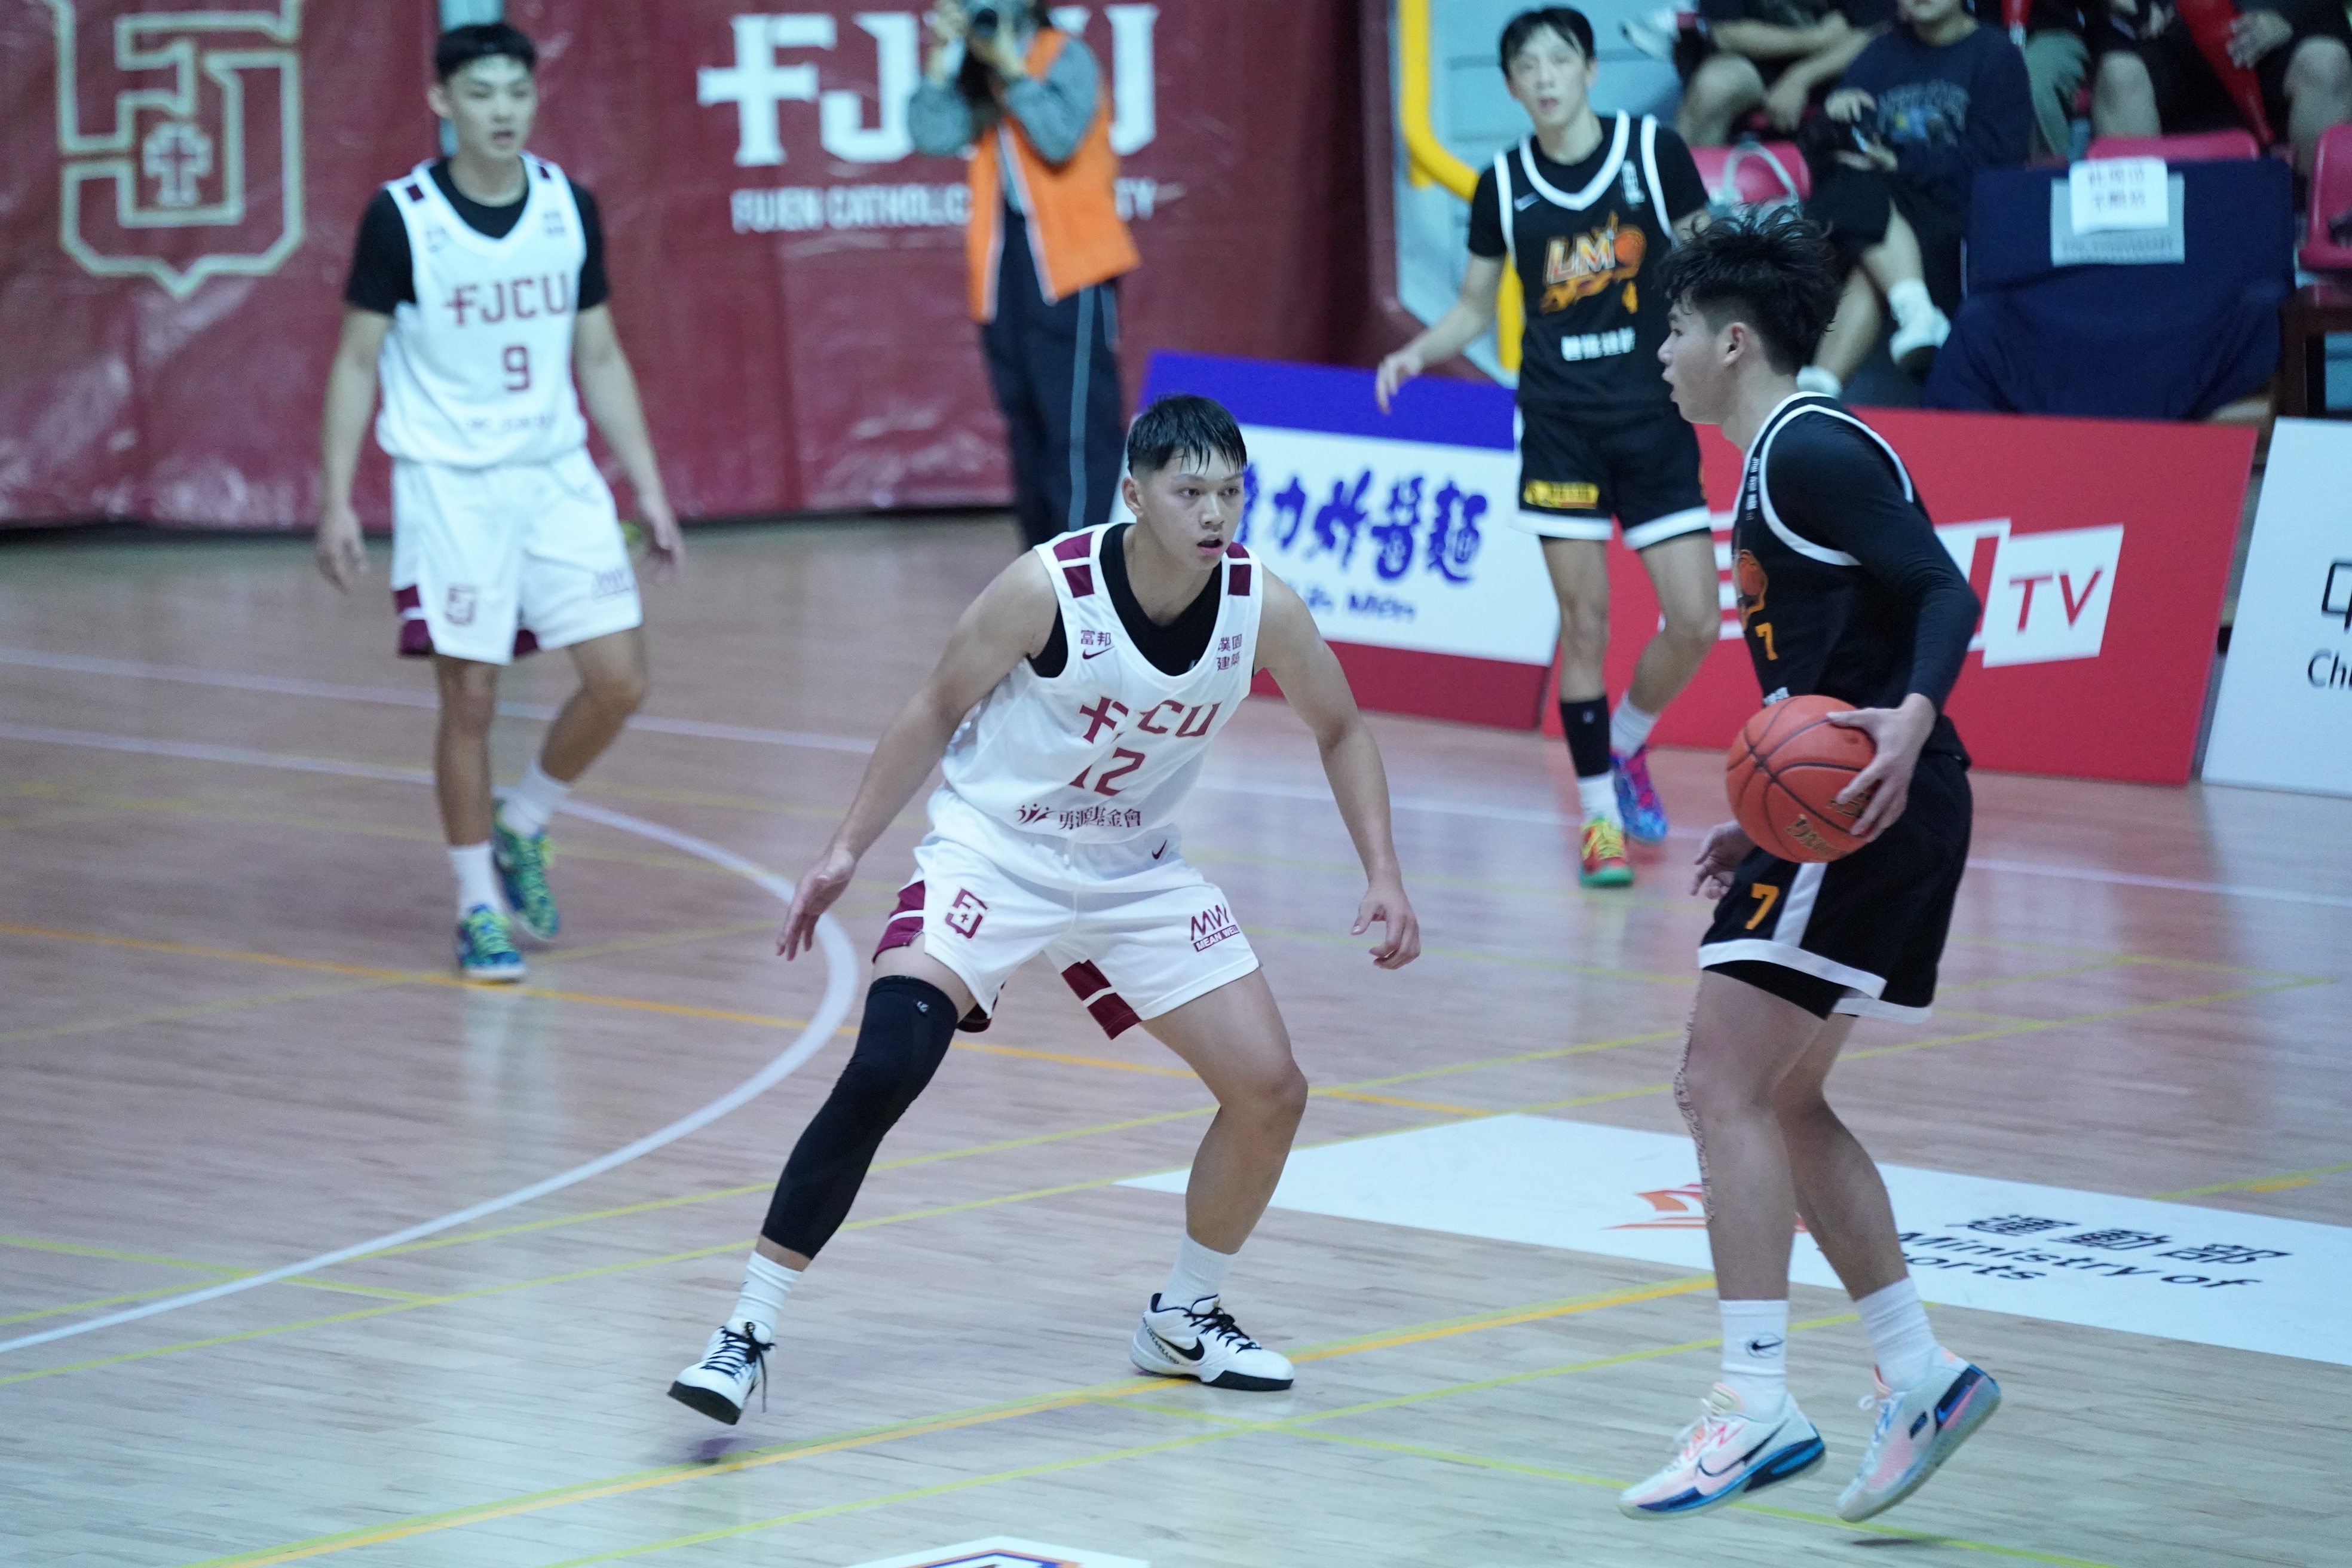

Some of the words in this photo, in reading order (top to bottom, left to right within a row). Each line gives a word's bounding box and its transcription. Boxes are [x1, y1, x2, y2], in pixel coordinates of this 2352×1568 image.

[445, 272, 569, 327] FJCU
[503, 345, 530, 393] 9
[2010, 568, 2103, 635] TV
[1080, 629, 1111, 647] 富邦
[1756, 623, 1778, 660] 7
[2307, 649, 2352, 690] Ch
[1079, 696, 1223, 745] FCU
[1745, 883, 1780, 930] 7
[1196, 932, 1223, 951] MEAN
[1221, 926, 1239, 938] WE
[1899, 1232, 2163, 1278] Ministry
[2160, 1274, 2264, 1289] of
[1944, 1214, 2294, 1264] 運動部
[1903, 1252, 2048, 1280] orts
